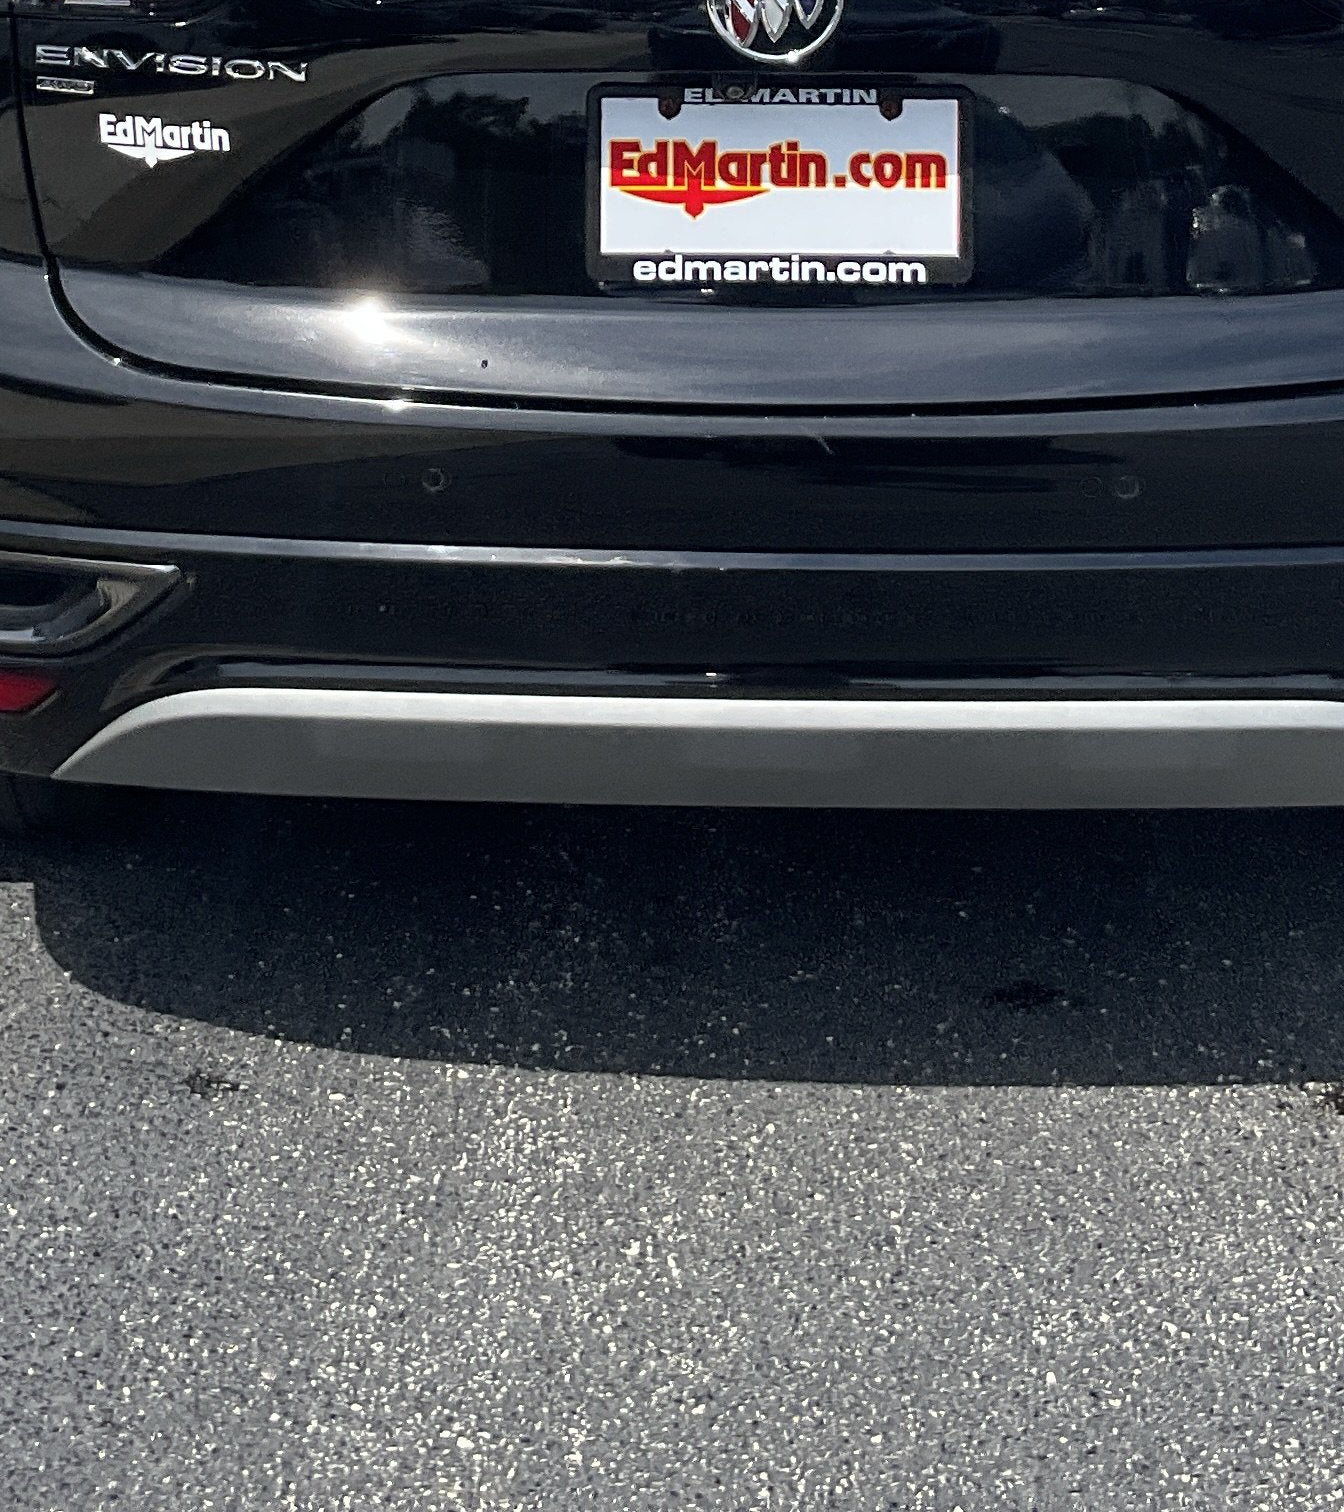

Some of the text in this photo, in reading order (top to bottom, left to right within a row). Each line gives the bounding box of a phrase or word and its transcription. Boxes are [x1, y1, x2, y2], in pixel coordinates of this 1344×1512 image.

[35, 44, 309, 83] ENVISION
[738, 88, 878, 104] MARTIN
[98, 112, 232, 156] EdMartin
[632, 254, 928, 284] edmartin.com
